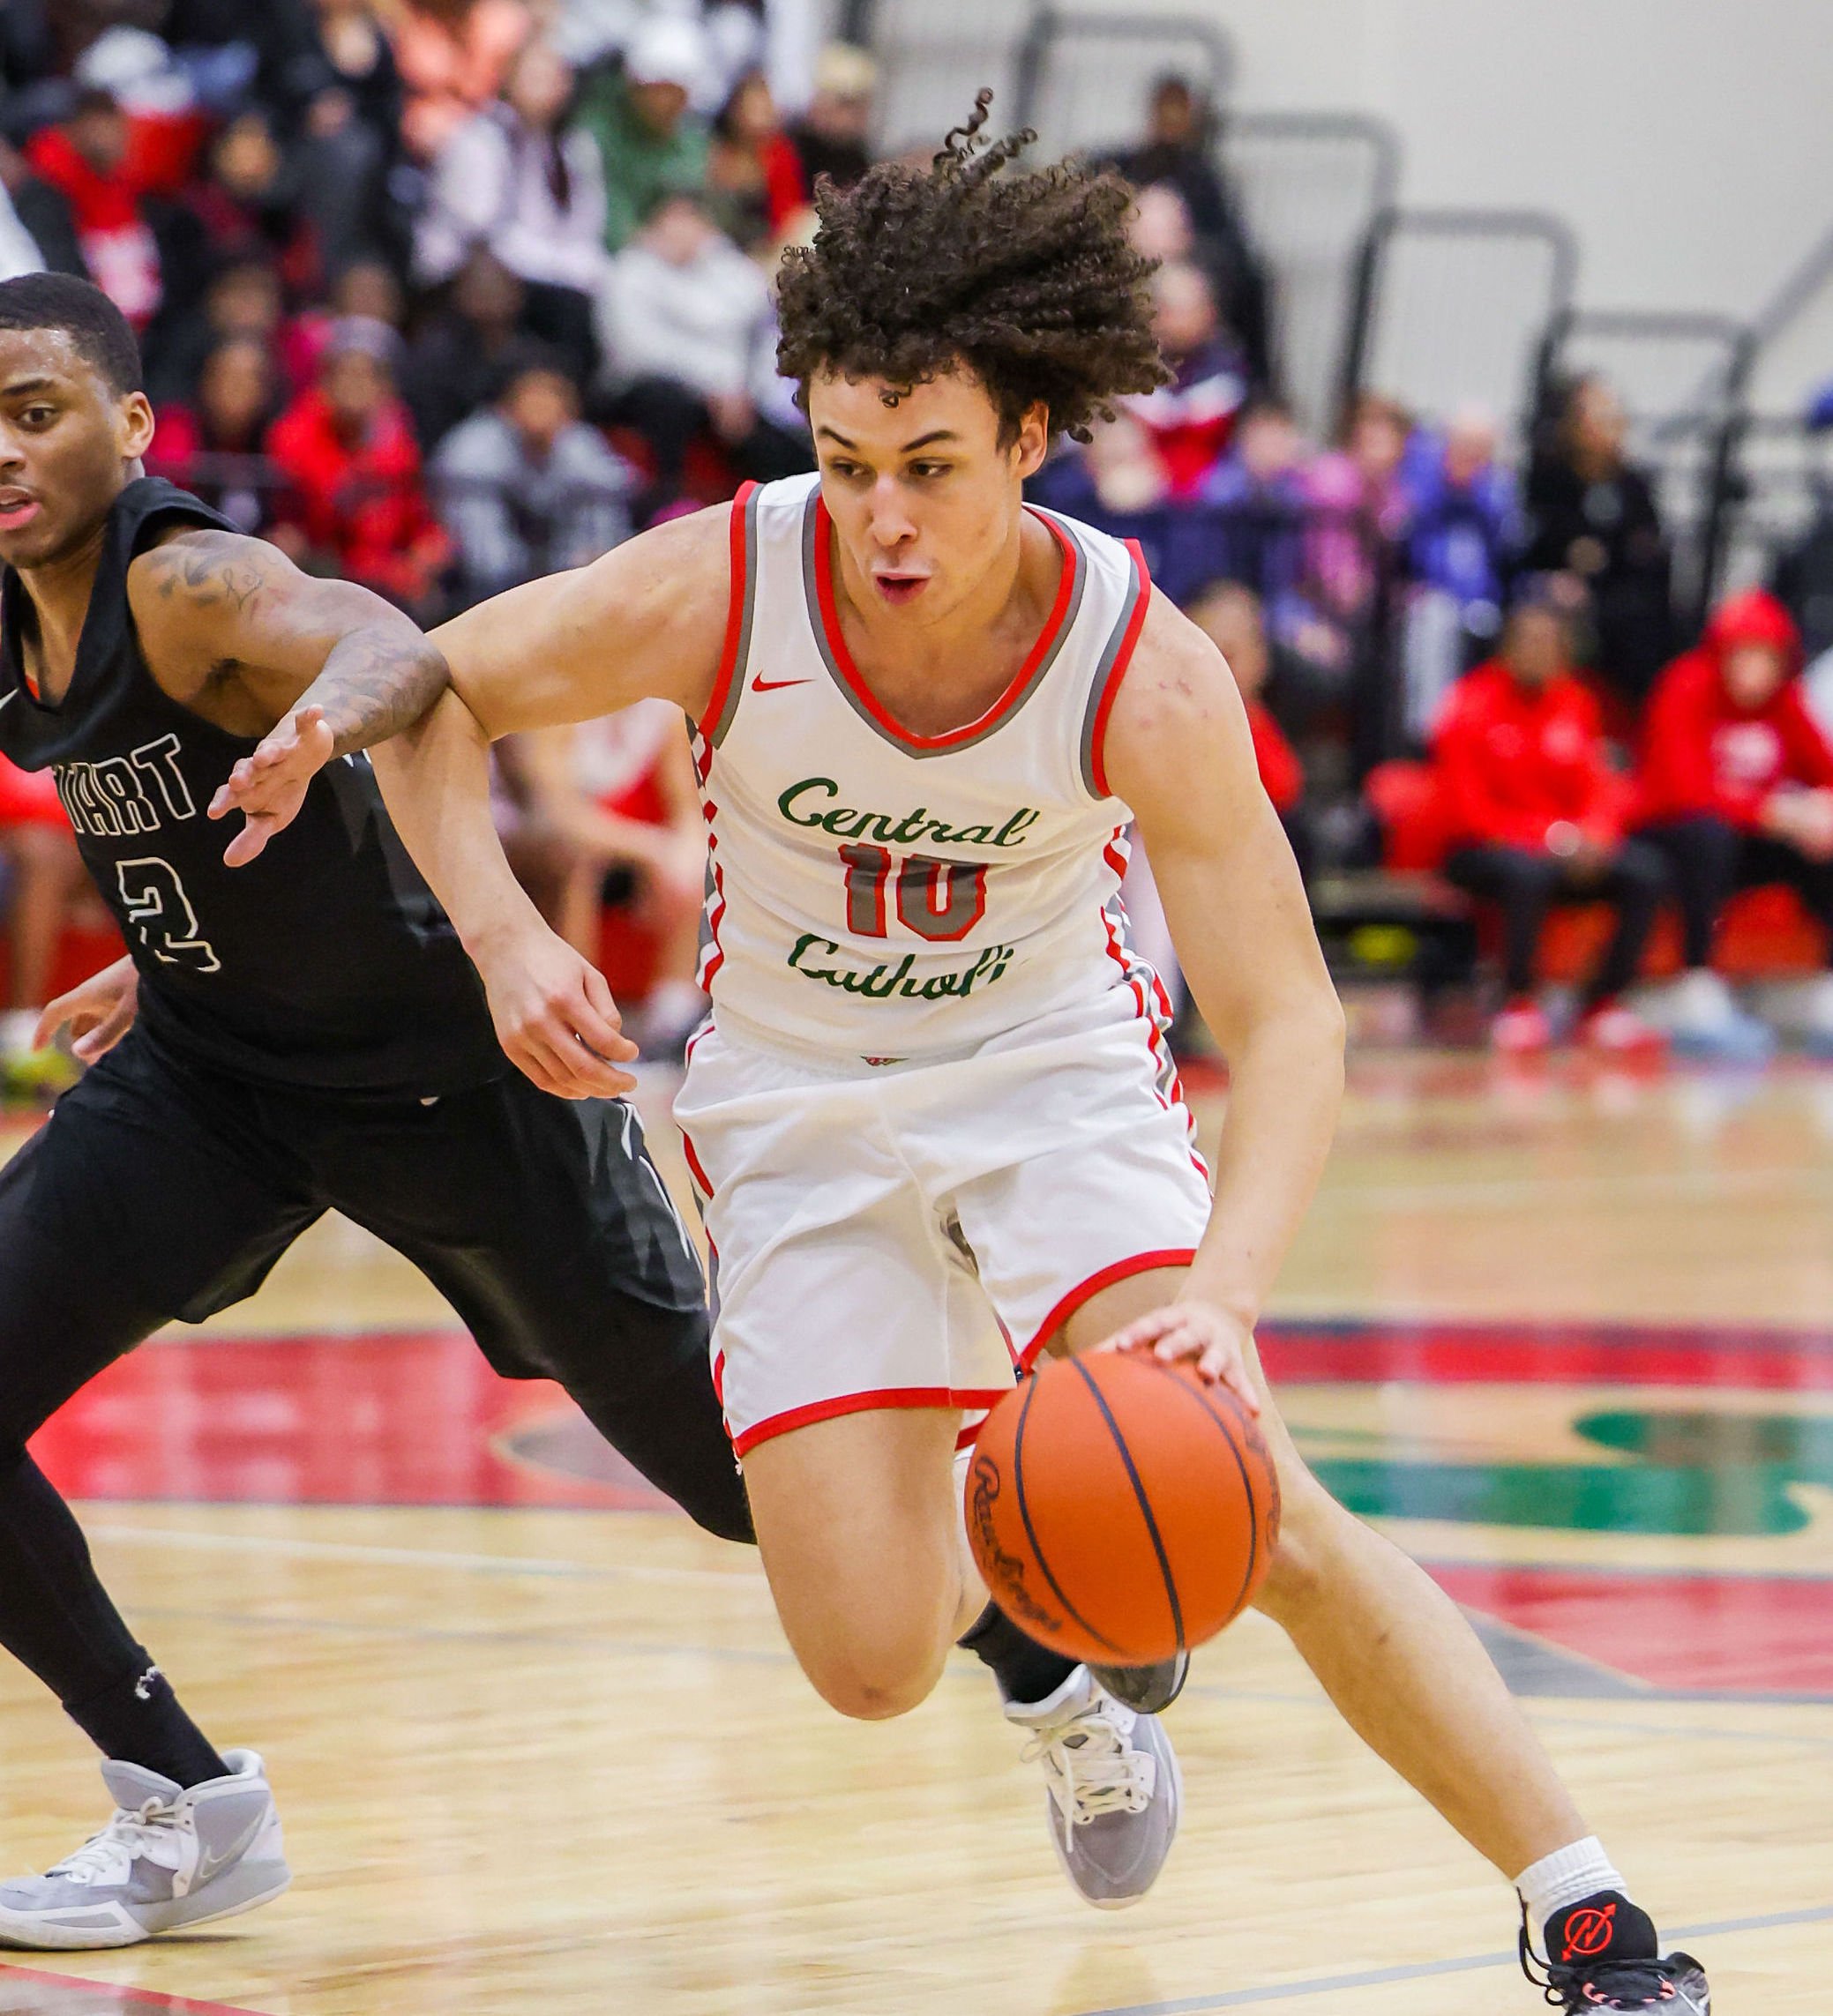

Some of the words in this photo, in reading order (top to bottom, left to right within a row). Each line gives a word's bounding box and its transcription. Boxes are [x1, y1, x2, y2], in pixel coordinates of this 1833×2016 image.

[777, 777, 1040, 847] Central
[116, 856, 221, 972] 2
[838, 842, 989, 942] 10
[788, 933, 1015, 1000] Catholi
